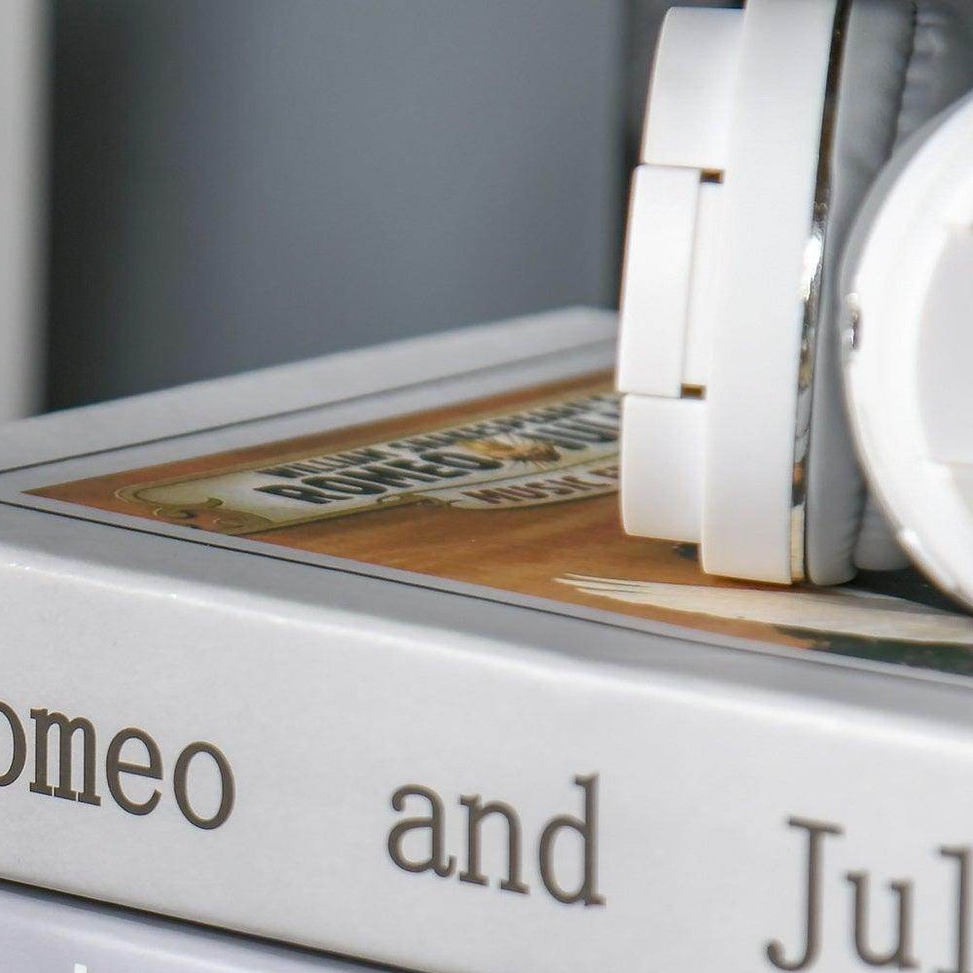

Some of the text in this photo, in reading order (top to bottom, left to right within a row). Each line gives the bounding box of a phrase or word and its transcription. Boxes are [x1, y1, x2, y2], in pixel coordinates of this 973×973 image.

[253, 452, 504, 504] ROMEO
[255, 448, 399, 479] WILLIAM
[460, 476, 611, 504] MUSIC
[387, 770, 607, 907] and
